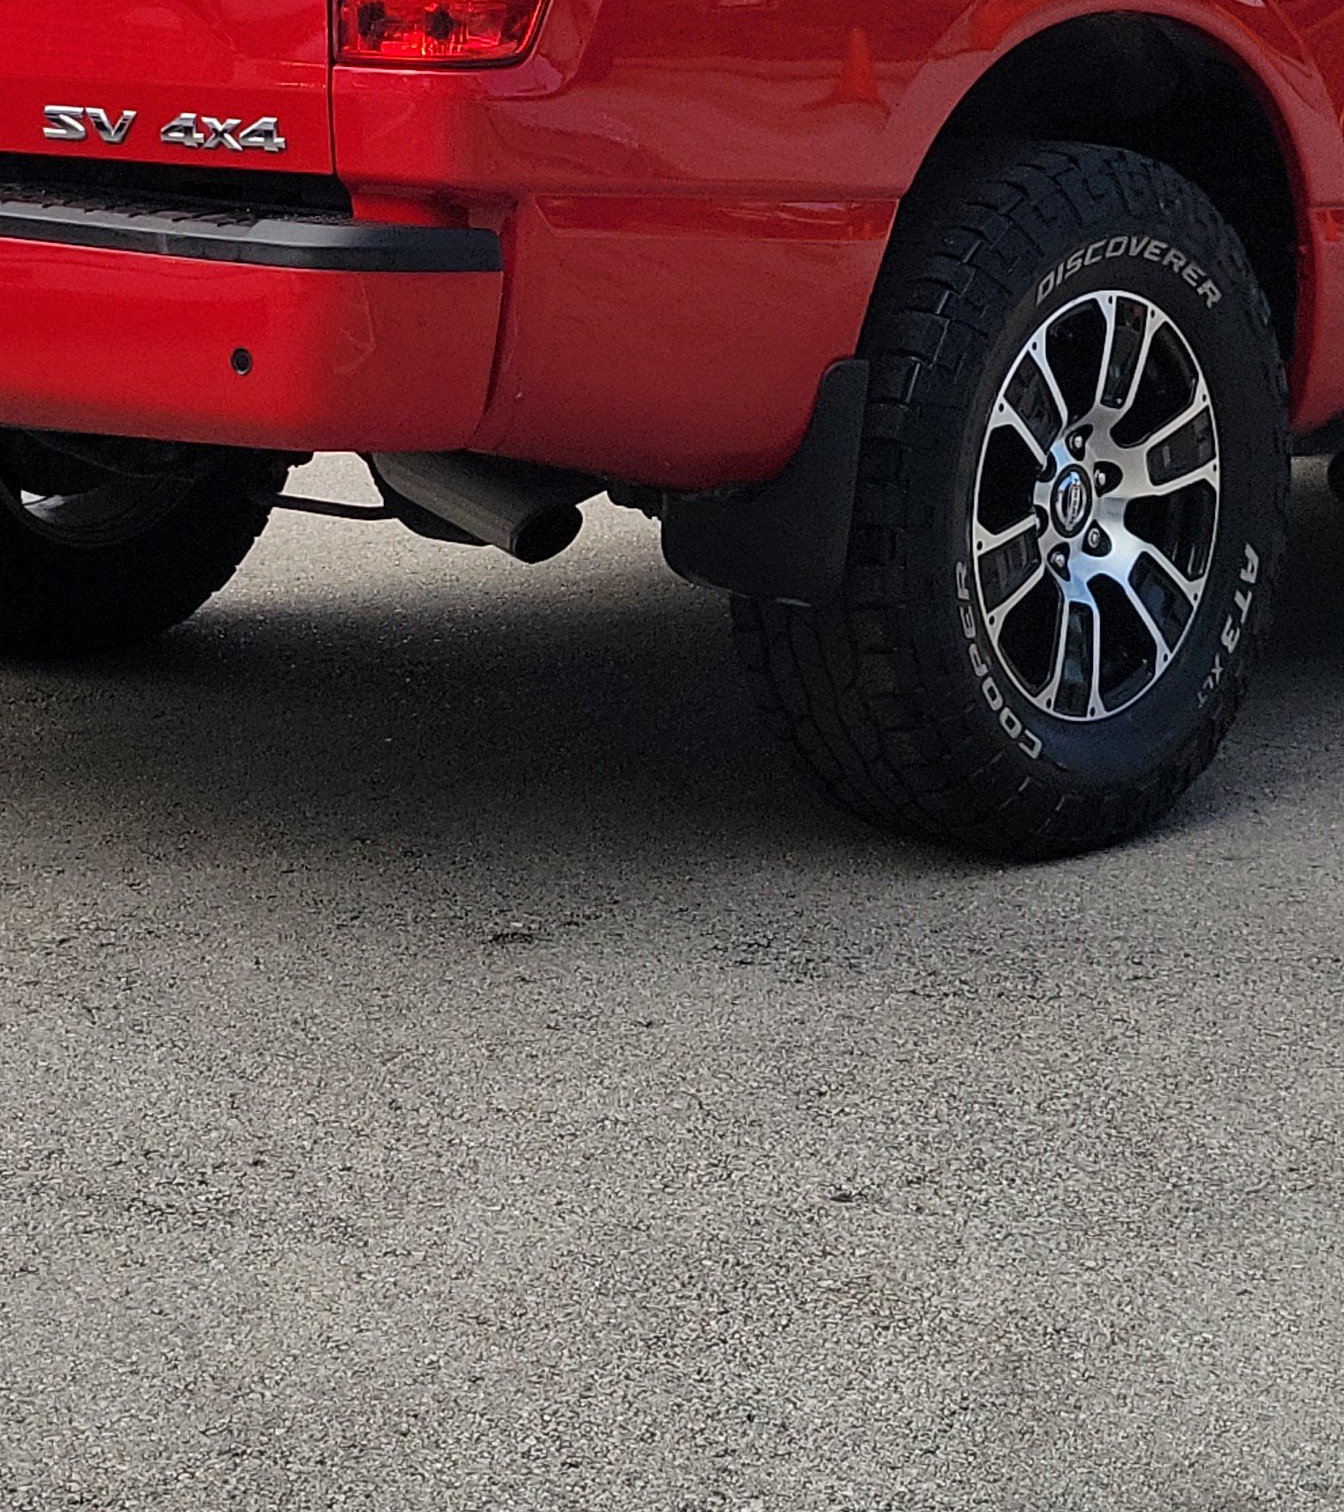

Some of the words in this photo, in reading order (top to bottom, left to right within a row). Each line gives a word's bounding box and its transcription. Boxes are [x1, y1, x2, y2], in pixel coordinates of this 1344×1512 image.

[43, 105, 137, 143] SV
[1035, 236, 1223, 309] DISCOVERER
[1220, 543, 1259, 654] AT3
[957, 561, 1042, 760] COOPER
